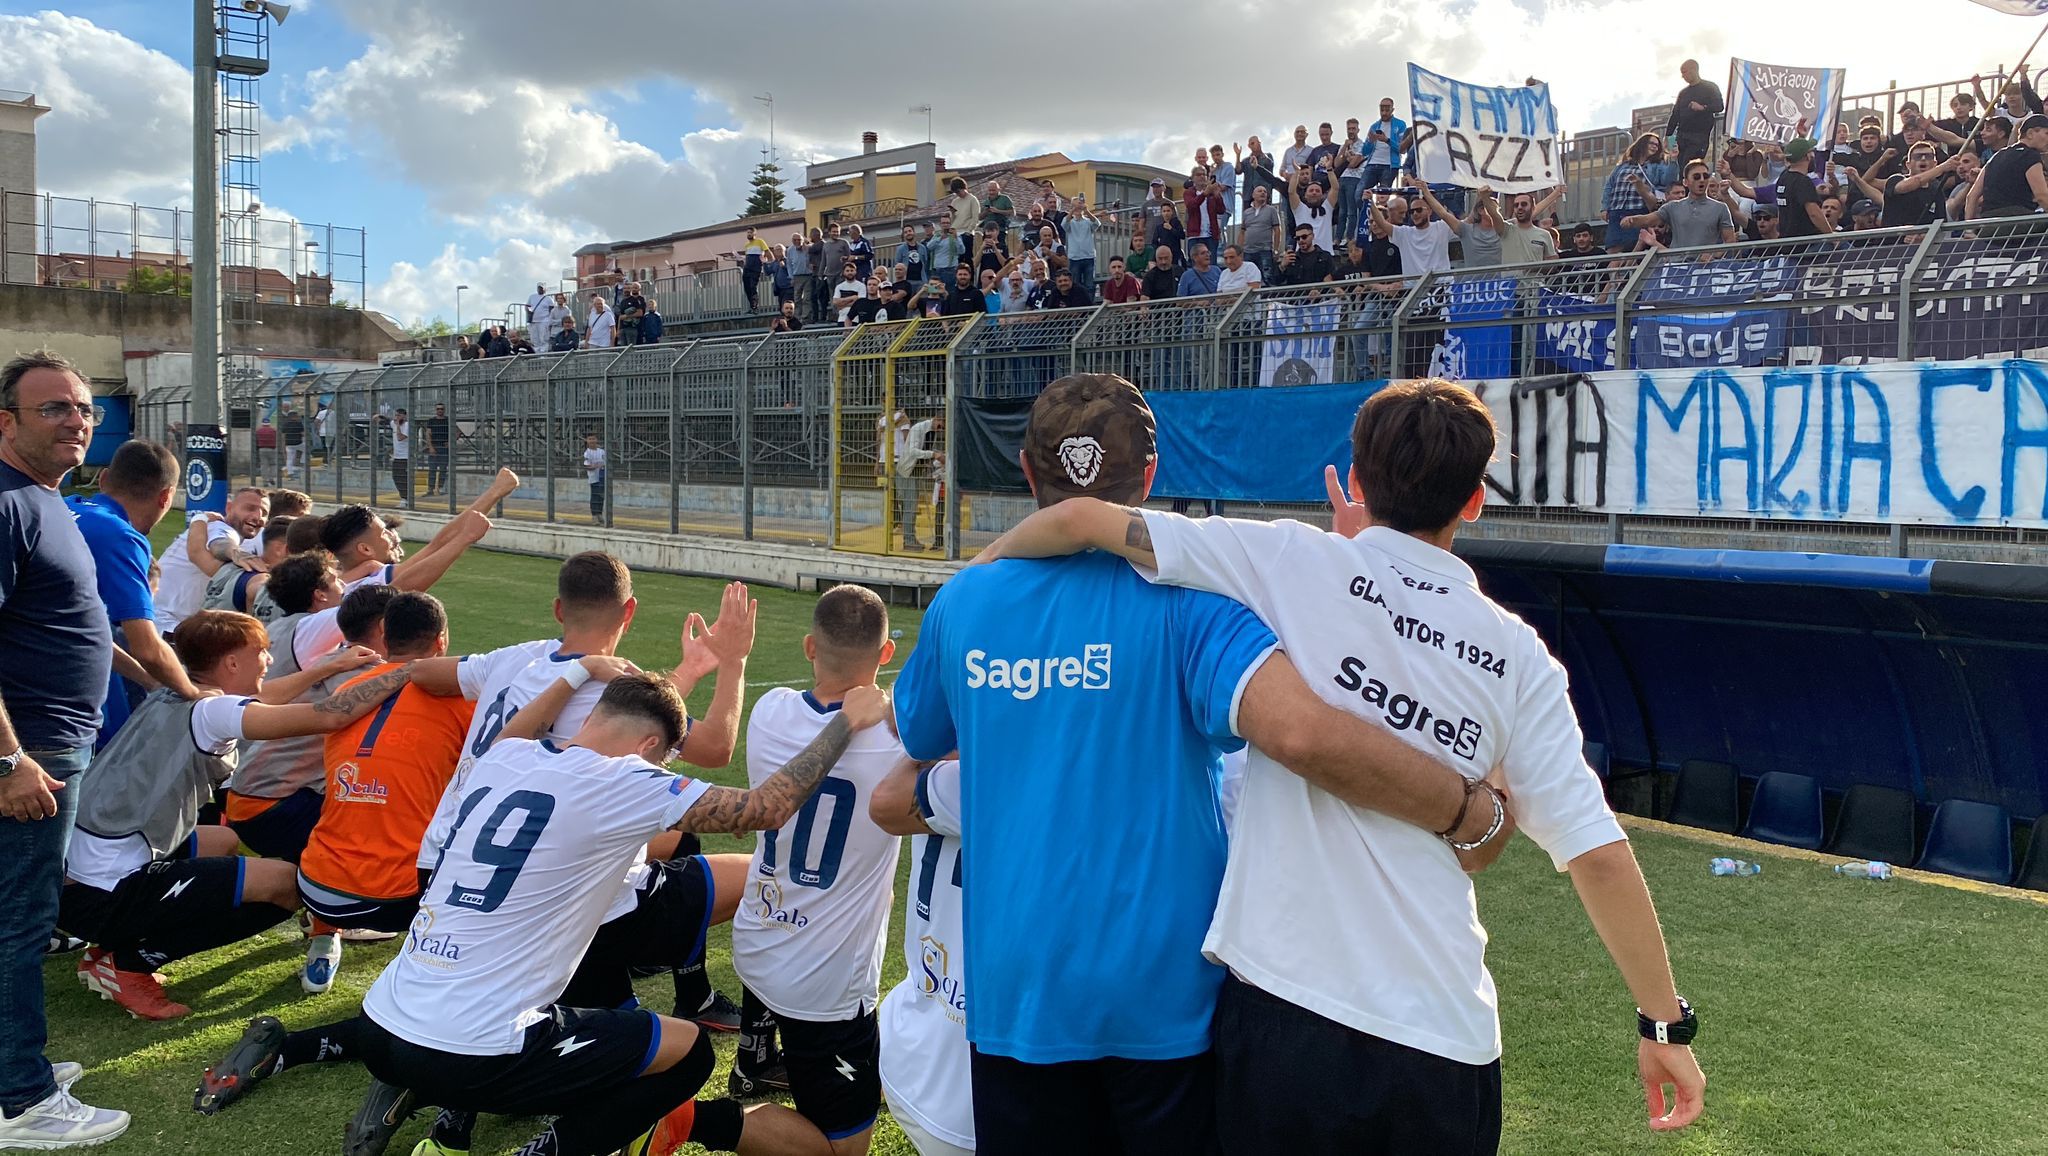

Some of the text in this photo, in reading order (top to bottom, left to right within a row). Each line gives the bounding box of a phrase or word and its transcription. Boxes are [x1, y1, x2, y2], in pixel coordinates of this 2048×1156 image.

[1410, 66, 1556, 136] STAMM
[1461, 281, 1511, 304] BLUE
[1659, 254, 1790, 303] Crazy
[1659, 323, 1770, 364] Boys
[1634, 365, 1892, 517] MARIA
[1389, 565, 1450, 595] eus
[1350, 576, 1506, 679] GLAATOR 1924
[423, 786, 556, 913] 19
